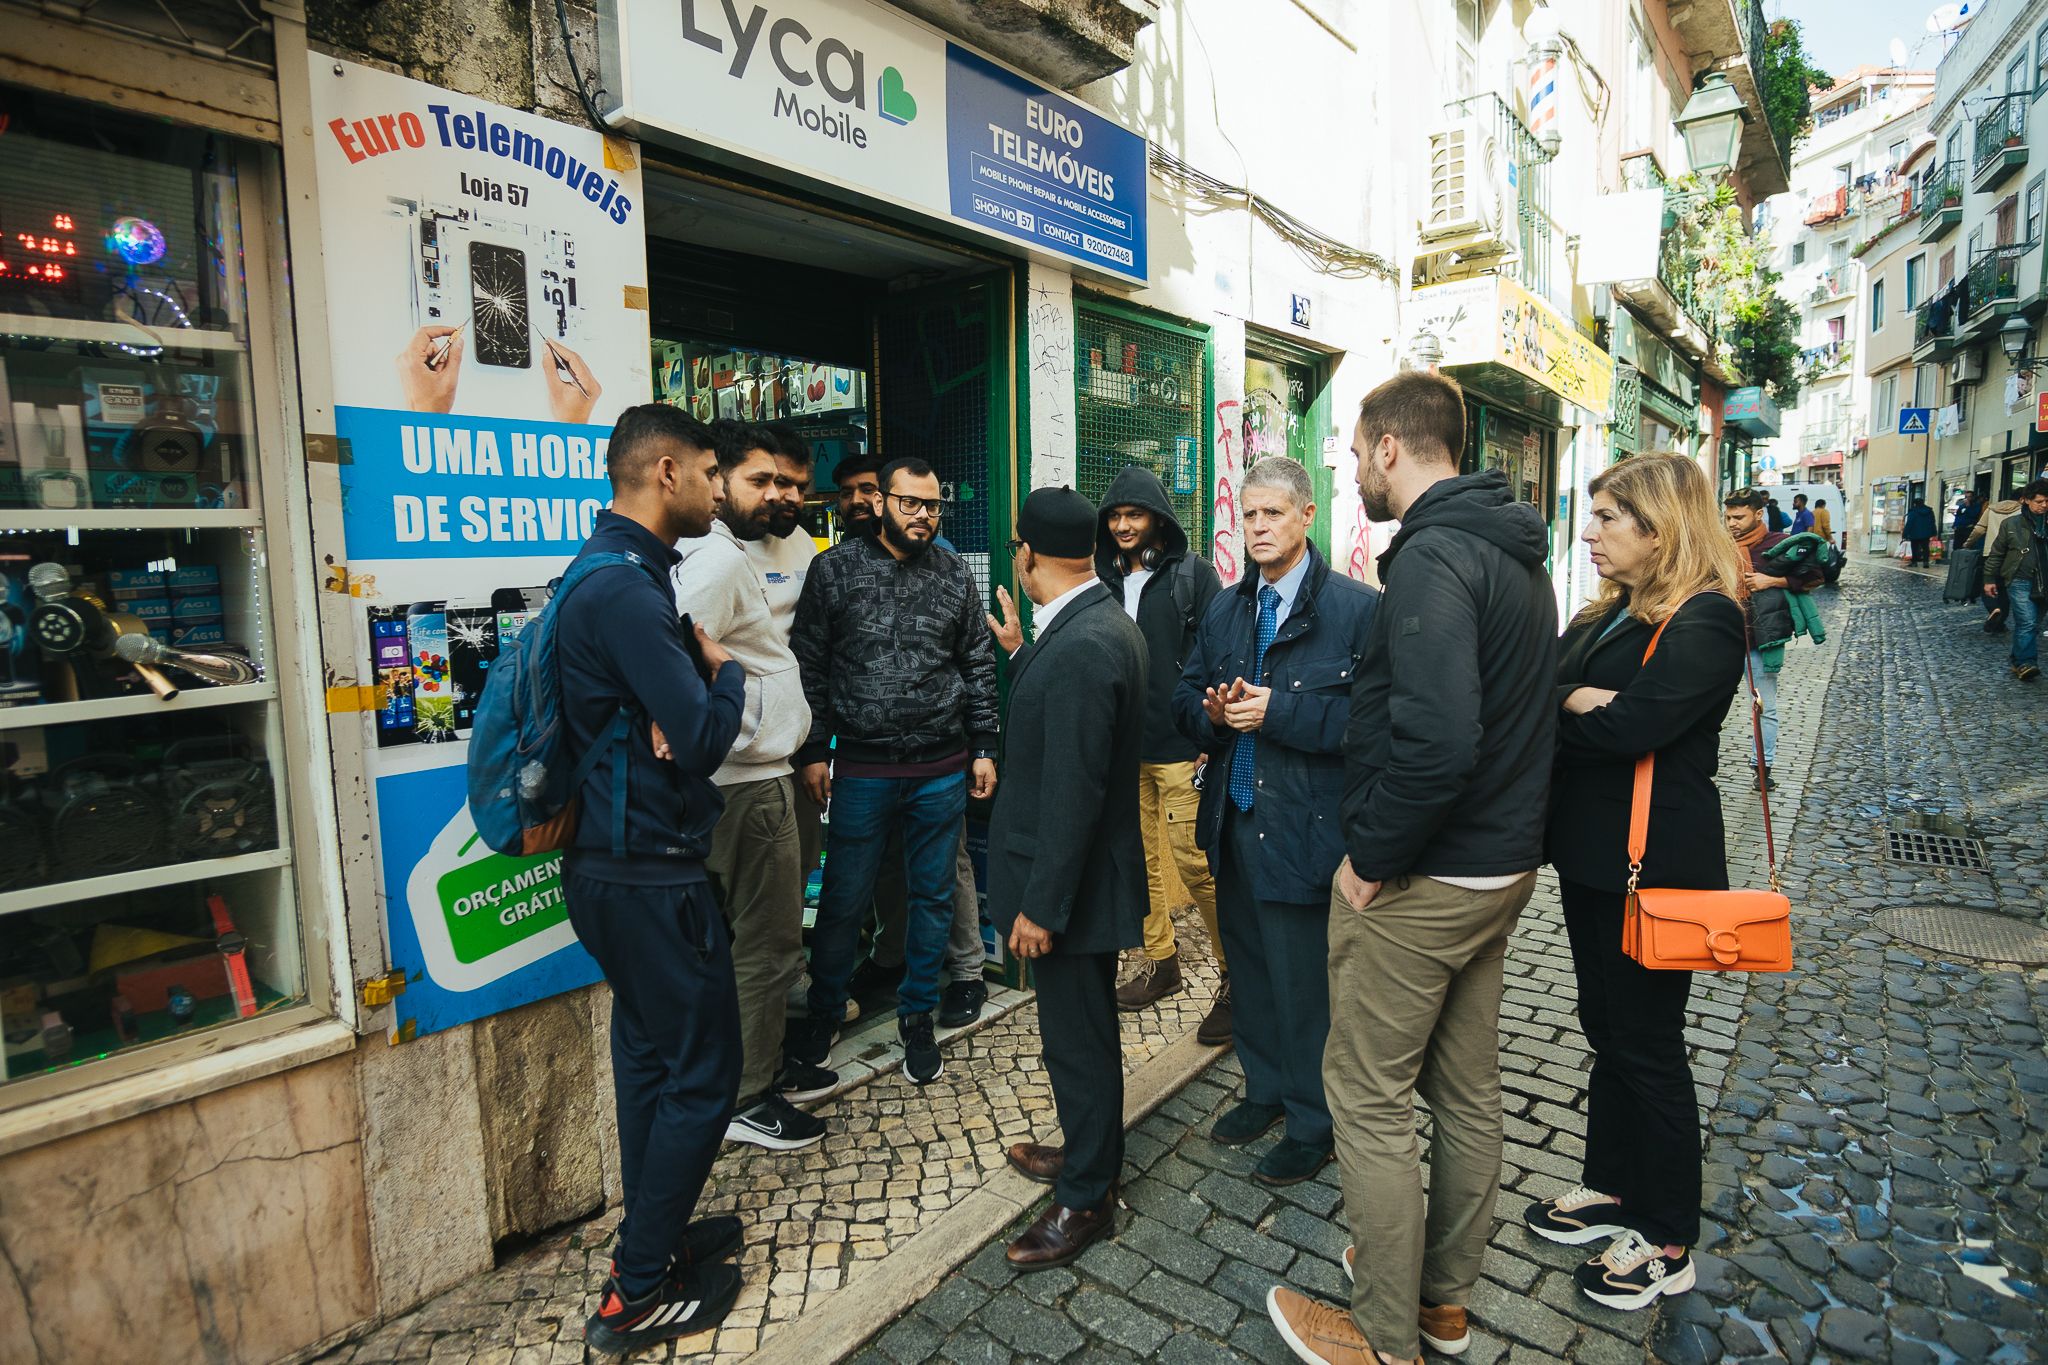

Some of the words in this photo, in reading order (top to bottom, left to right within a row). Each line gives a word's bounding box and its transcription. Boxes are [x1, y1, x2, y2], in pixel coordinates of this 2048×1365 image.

[774, 87, 867, 149] Mobile
[1026, 98, 1083, 149] EURO
[328, 111, 426, 165] Euro
[427, 104, 632, 225] Telemoveis
[989, 123, 1114, 202] TELEMÓVEIS
[460, 172, 503, 203] Loja
[507, 183, 529, 208] 57
[975, 199, 1000, 217] SHOP
[1001, 208, 1016, 222] NO
[1021, 213, 1032, 228] 57
[979, 165, 1007, 185] MOBILE
[1008, 176, 1033, 194] PHONE
[1034, 186, 1056, 203] REPAIR
[1057, 196, 1063, 205] &
[1063, 198, 1086, 215] MOBILE
[1087, 208, 1126, 230] ACCESSORIES
[1043, 224, 1079, 245] CONTACT
[1087, 237, 1130, 263] 920027468
[1725, 402, 1759, 415] 67-A
[401, 425, 503, 476] UMA
[511, 432, 610, 480] HORA
[393, 495, 451, 543] DE
[136, 606, 167, 616] AG10
[192, 631, 221, 641] AG10
[452, 856, 563, 916] ORÇAMEN
